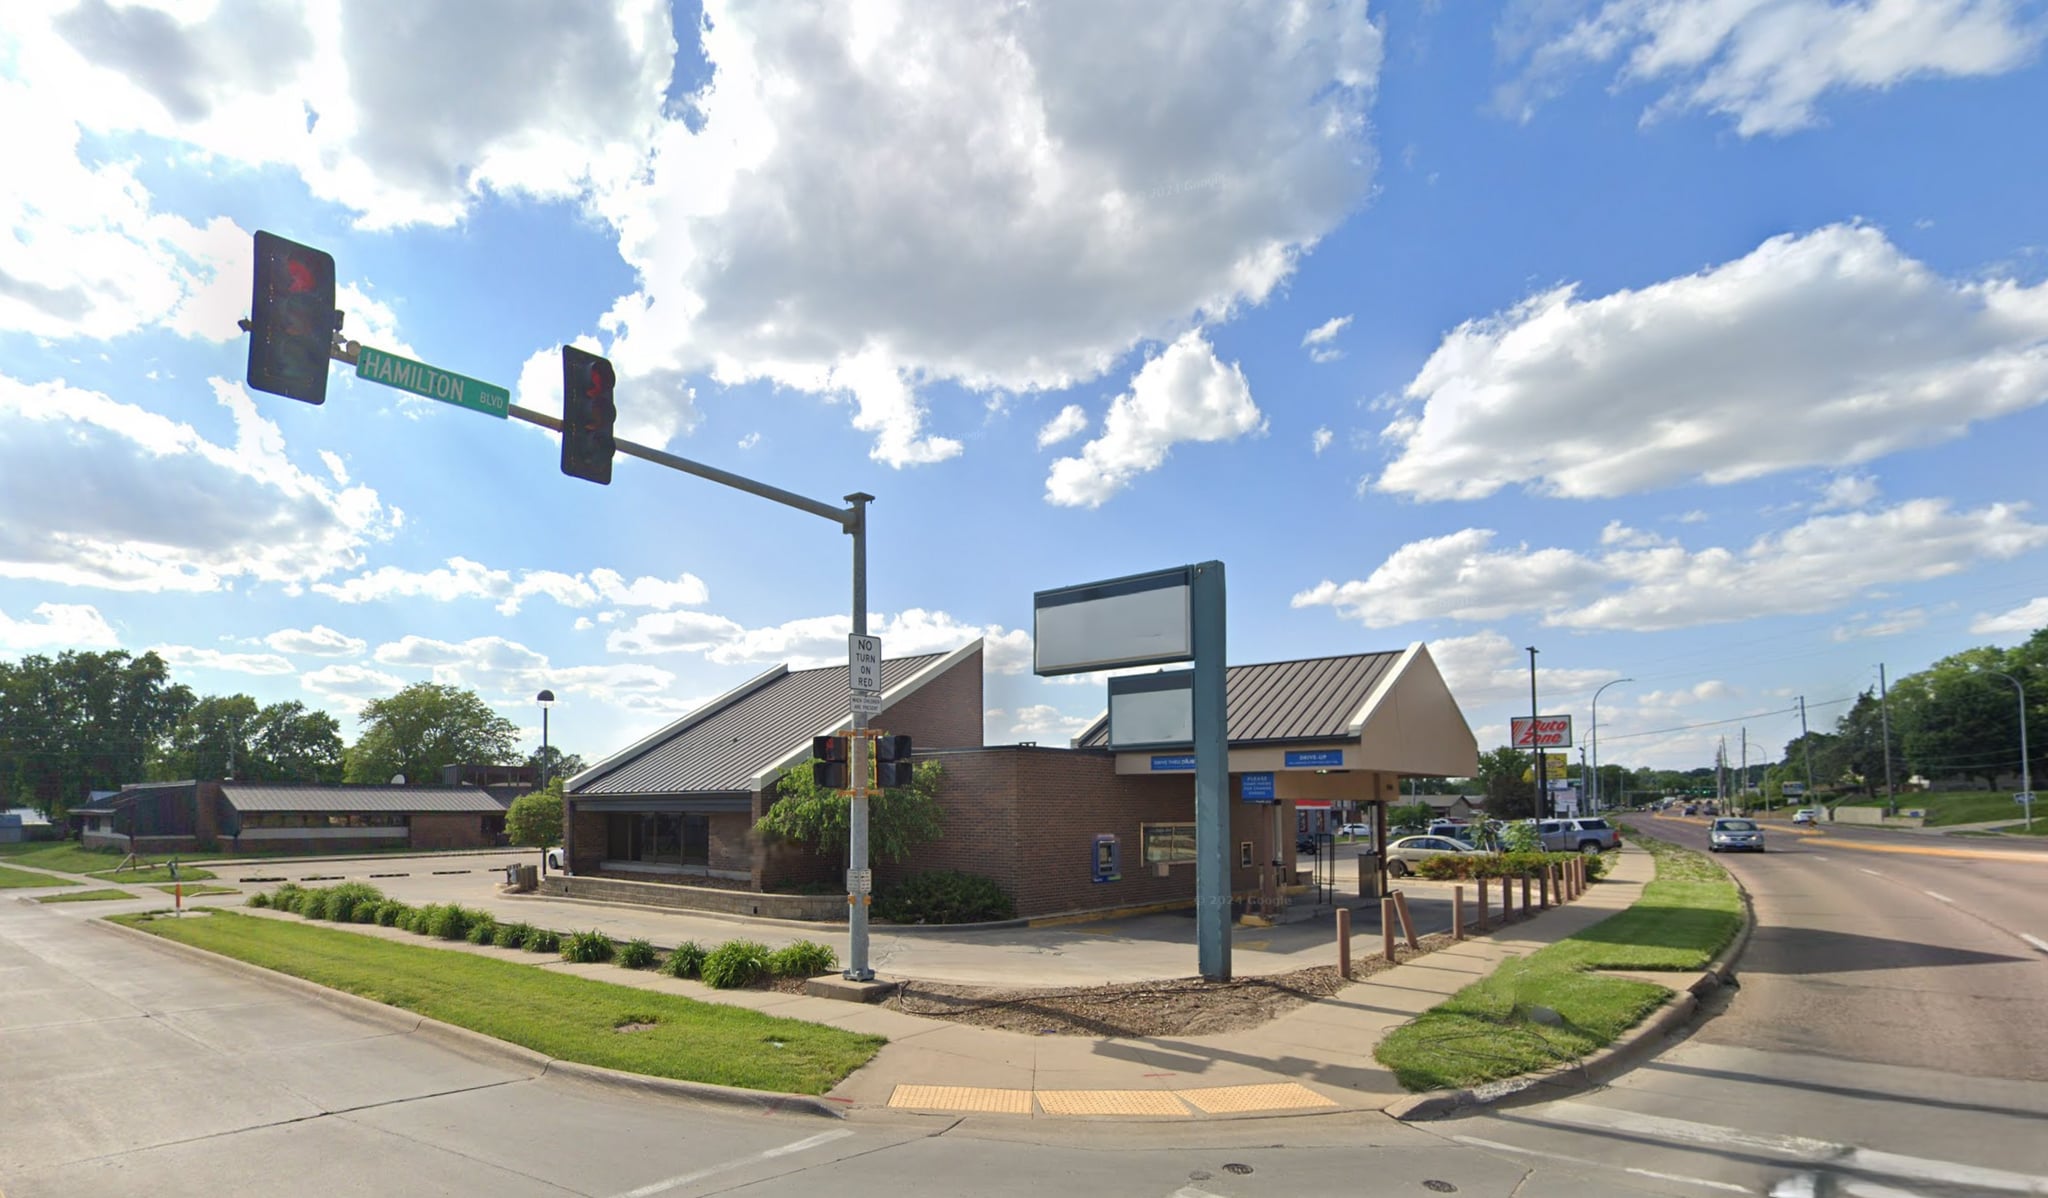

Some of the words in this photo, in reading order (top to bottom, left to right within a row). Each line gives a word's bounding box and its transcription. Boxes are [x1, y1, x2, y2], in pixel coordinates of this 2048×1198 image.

[363, 351, 465, 402] HAMILTON
[480, 391, 503, 409] BLVD
[858, 639, 872, 651] NO
[856, 653, 875, 663] TURN
[860, 665, 871, 675] ON
[858, 677, 873, 687] RED
[1527, 720, 1567, 732] Auto
[1519, 732, 1563, 746] Zone
